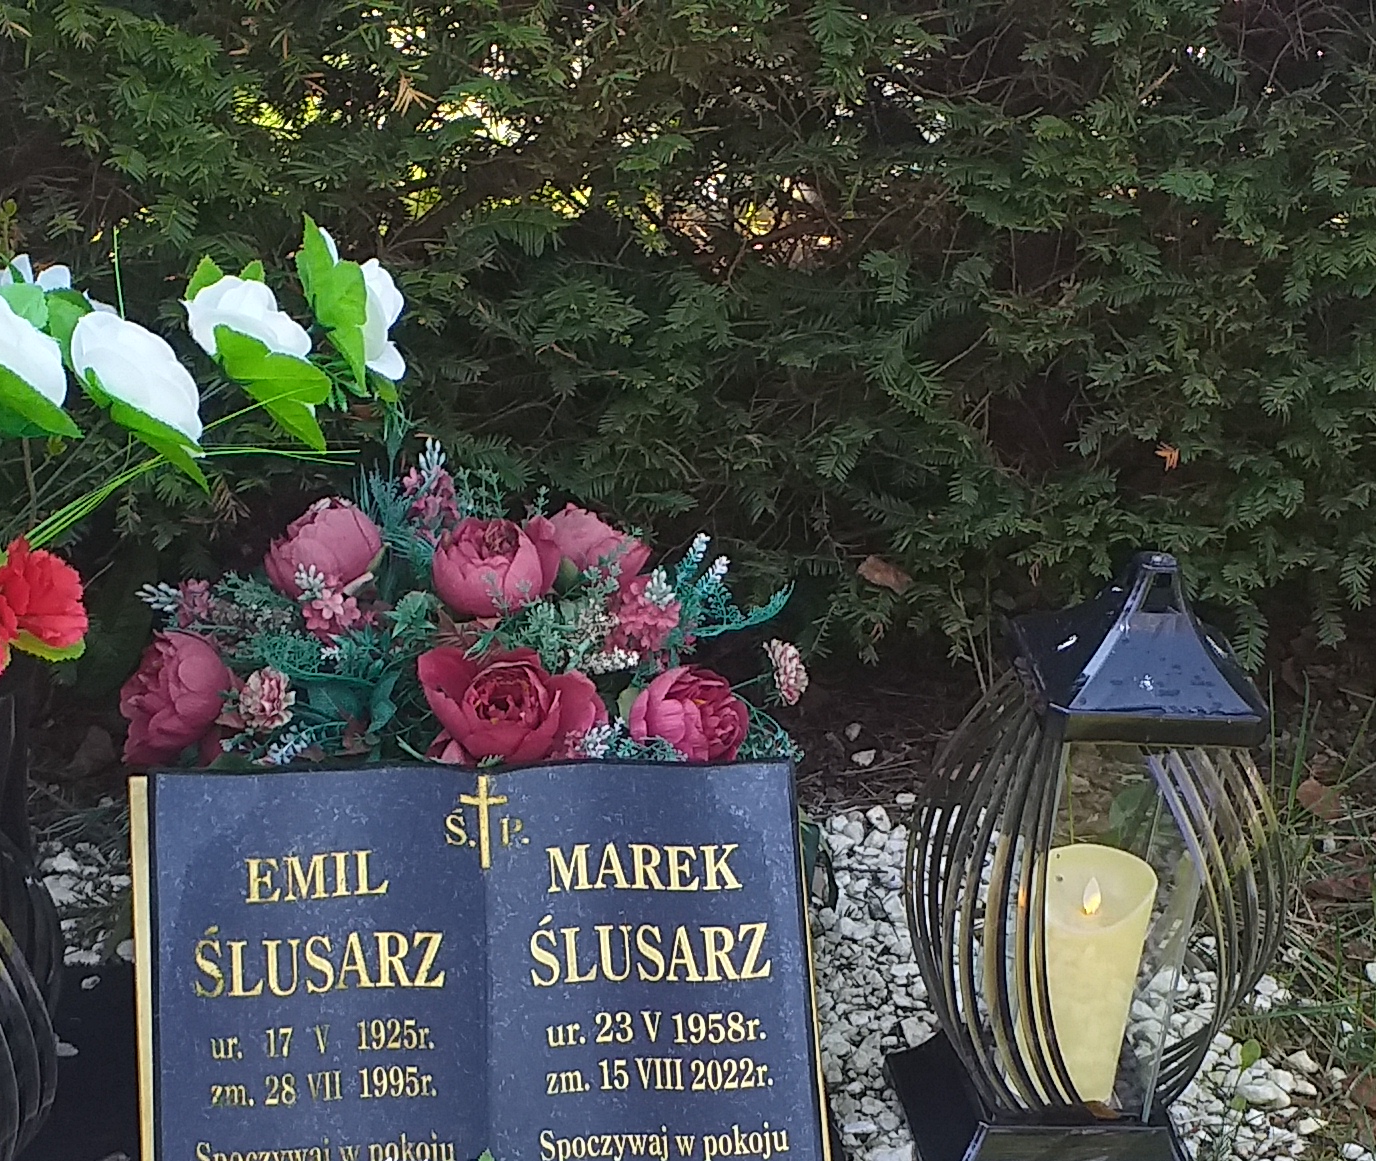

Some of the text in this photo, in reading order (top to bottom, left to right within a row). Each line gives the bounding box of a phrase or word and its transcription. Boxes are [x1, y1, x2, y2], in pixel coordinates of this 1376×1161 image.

[244, 849, 389, 904] EMIL
[546, 842, 743, 894] MAREK
[192, 925, 446, 999] ŚLUSARZ
[529, 914, 772, 988] ŚLUSARZ
[210, 1017, 436, 1061] ur. 17 V 1925r.
[546, 1011, 767, 1048] ur. 23 V 1958r.
[210, 1065, 438, 1108] zm. 28 VII 1995r.
[545, 1058, 775, 1095] zm. 15 VIII 2022r.
[675, 1133, 697, 1158] w
